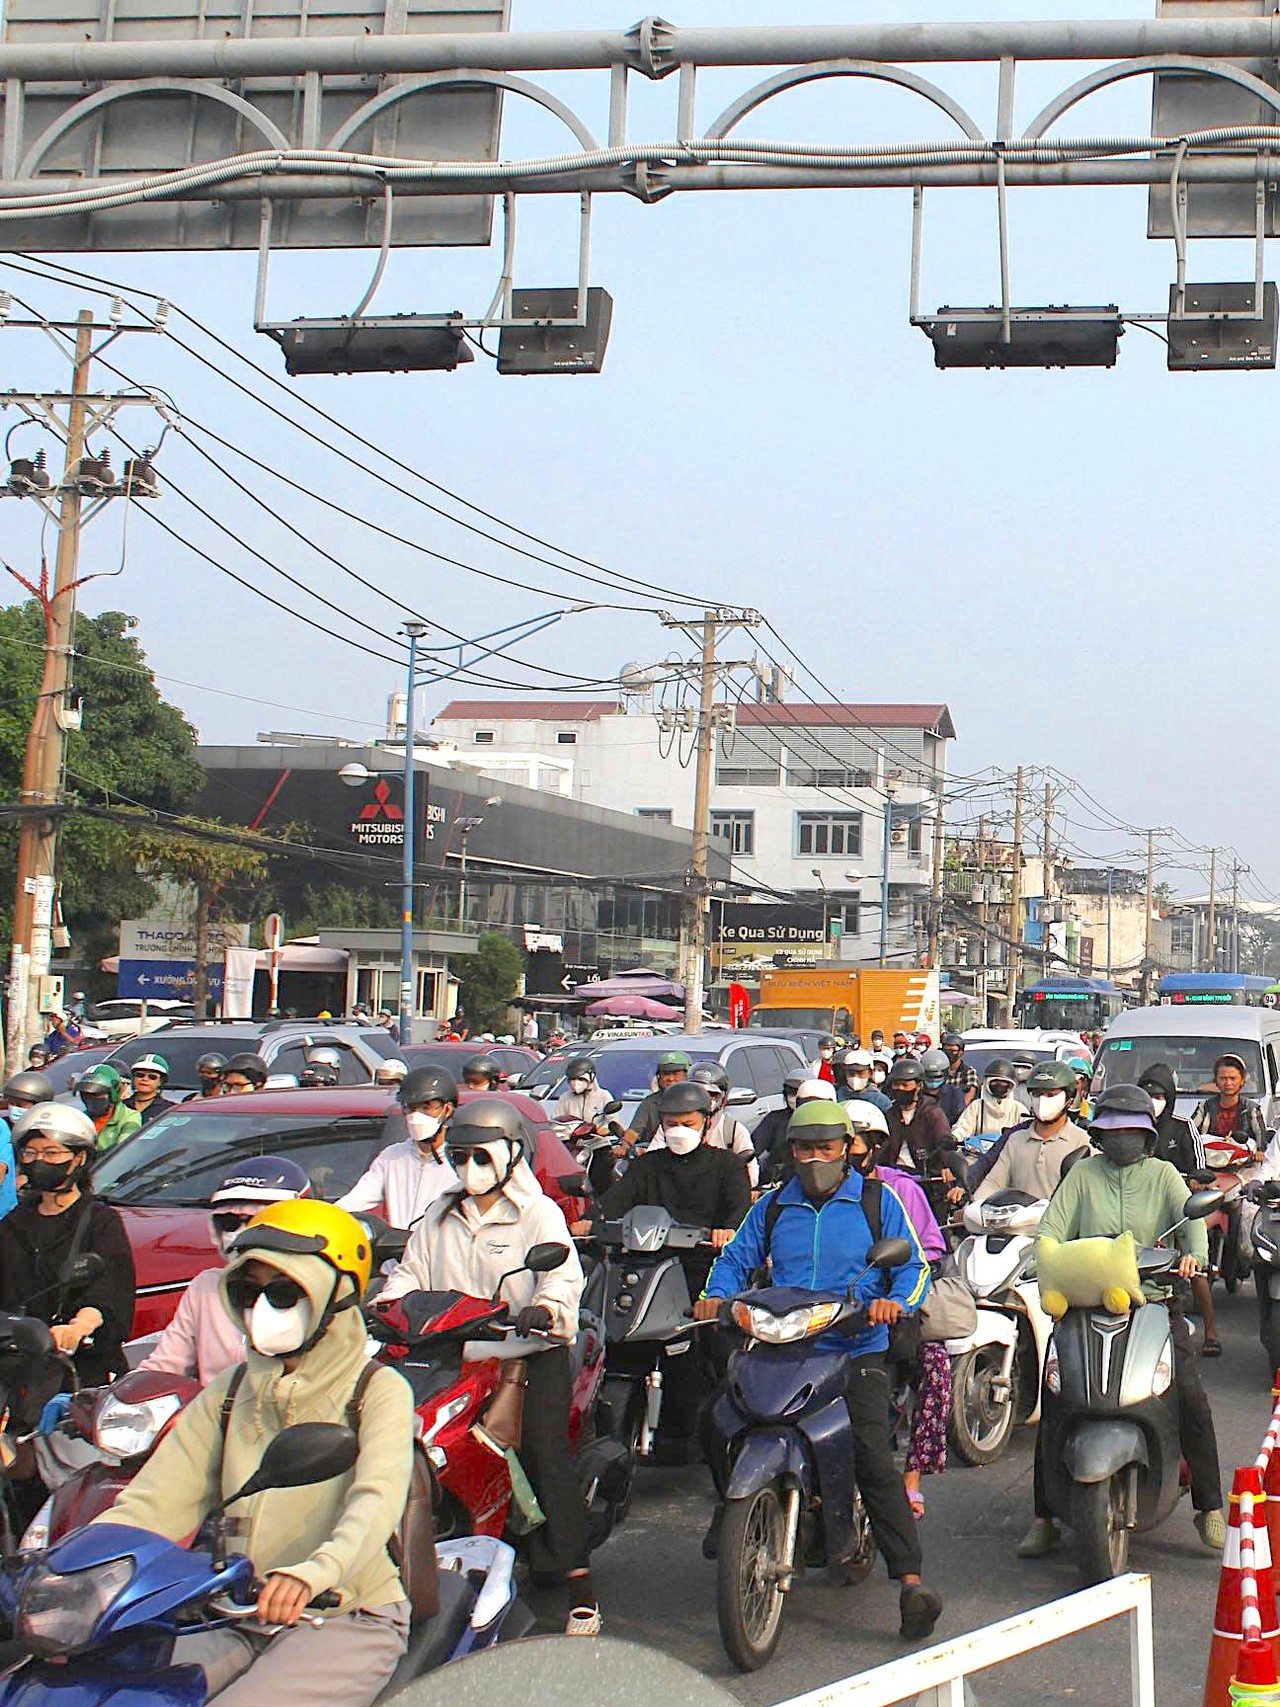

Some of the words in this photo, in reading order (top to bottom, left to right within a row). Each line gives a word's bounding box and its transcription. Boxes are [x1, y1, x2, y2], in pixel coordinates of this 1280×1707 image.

[351, 823, 404, 833] MITSUBIS
[359, 834, 404, 844] MOTORS
[137, 931, 183, 940] THACO
[719, 926, 735, 938] Xe
[738, 926, 764, 940] Qua
[767, 925, 786, 939] Sử
[788, 927, 824, 942] Dụng
